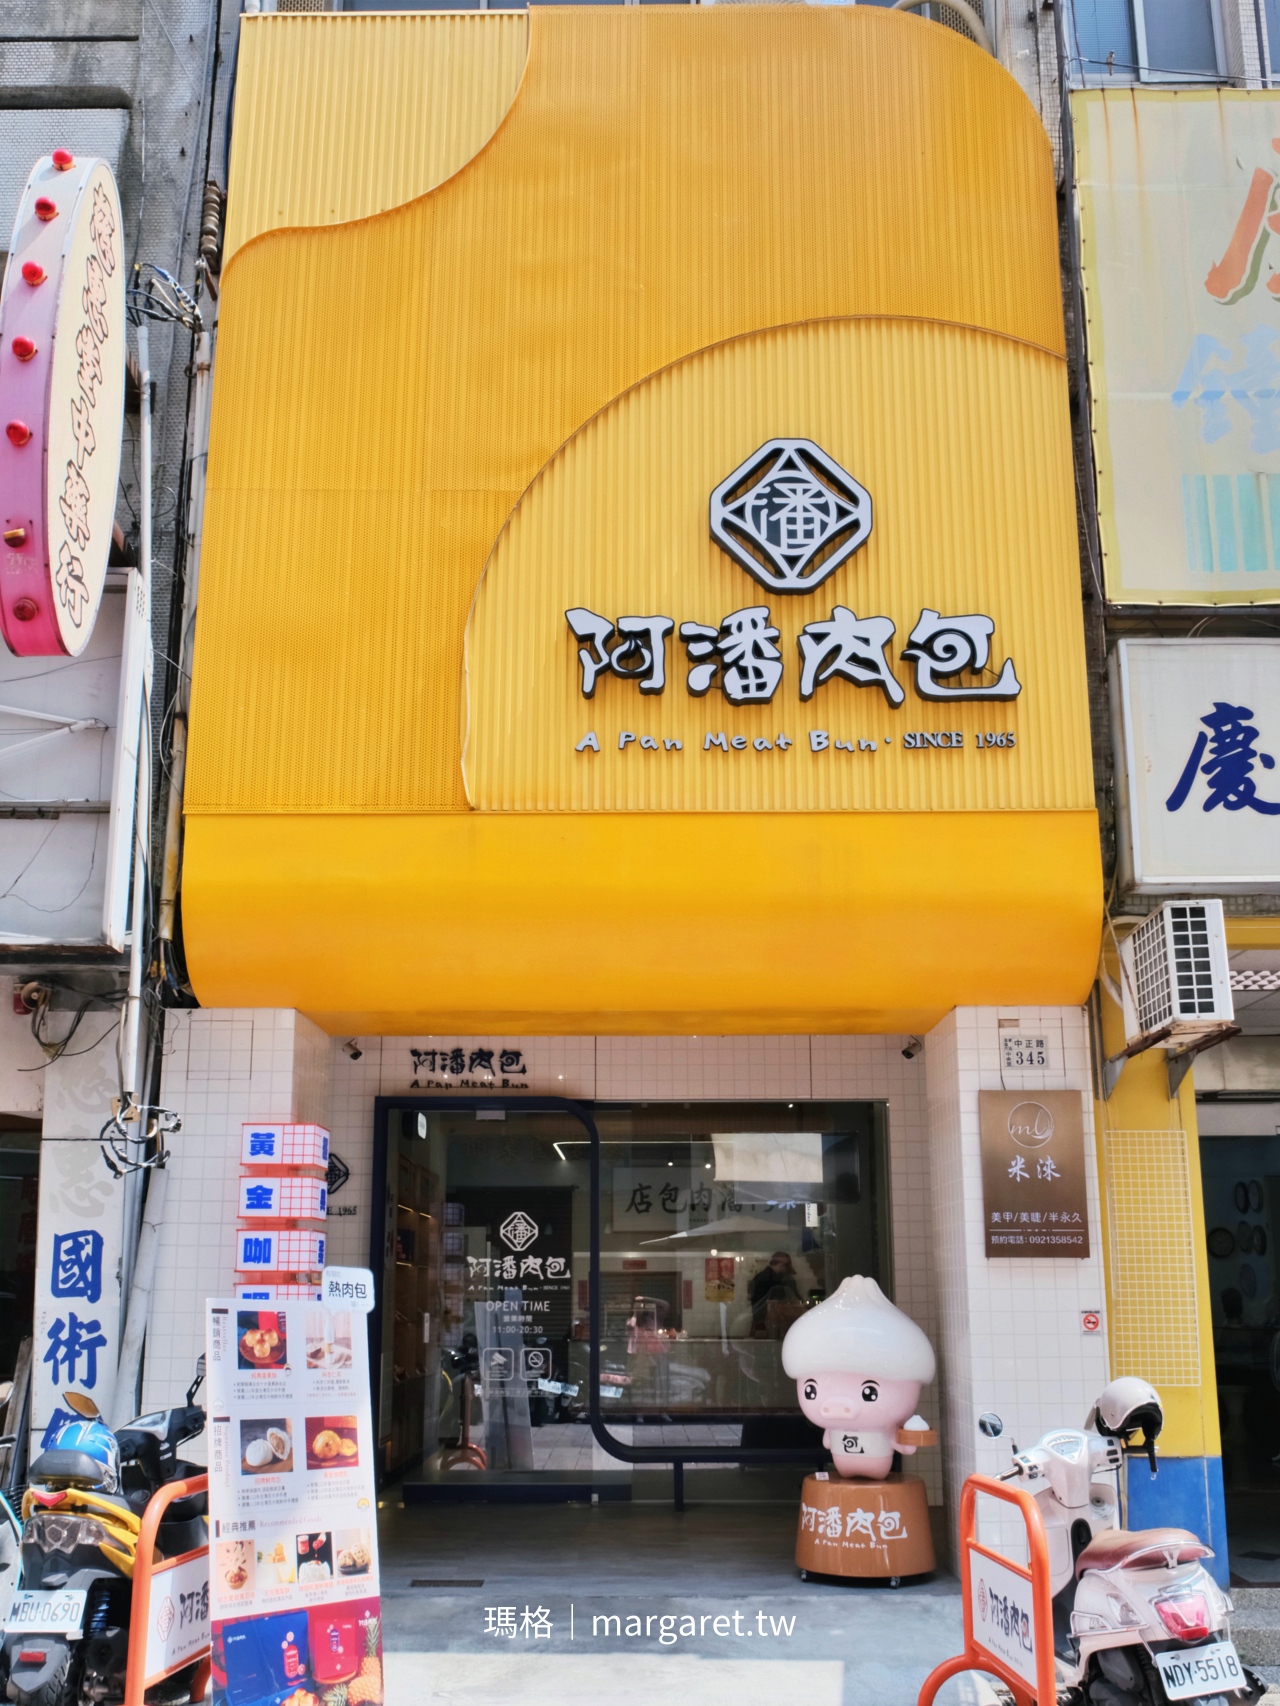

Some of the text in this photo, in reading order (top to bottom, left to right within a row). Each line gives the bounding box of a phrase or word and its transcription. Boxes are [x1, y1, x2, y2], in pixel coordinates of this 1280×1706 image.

[564, 605, 1022, 709] 阿潘肉包
[575, 732, 601, 753] A
[618, 731, 684, 751] Pan
[703, 732, 793, 752] Meat
[903, 731, 964, 749] SINCE
[976, 731, 1017, 749] 1965
[1014, 1039, 1045, 1048] 中正路
[410, 1048, 527, 1076] 阿潘肉包
[1016, 1051, 1045, 1065] 345
[427, 1079, 453, 1090] Pan
[460, 1079, 495, 1089] Meat
[502, 1079, 529, 1089] Bun
[242, 1132, 276, 1300] 黃金咖
[466, 1255, 571, 1280] 阿潘肉包
[328, 1281, 367, 1298] 熱肉包
[486, 1301, 550, 1312] OPEN TIME
[503, 1315, 533, 1323] 營業時間
[842, 1434, 864, 1454] 包
[801, 1502, 908, 1541] 阿潘肉包
[989, 1587, 1033, 1653] 阿潘肉包
